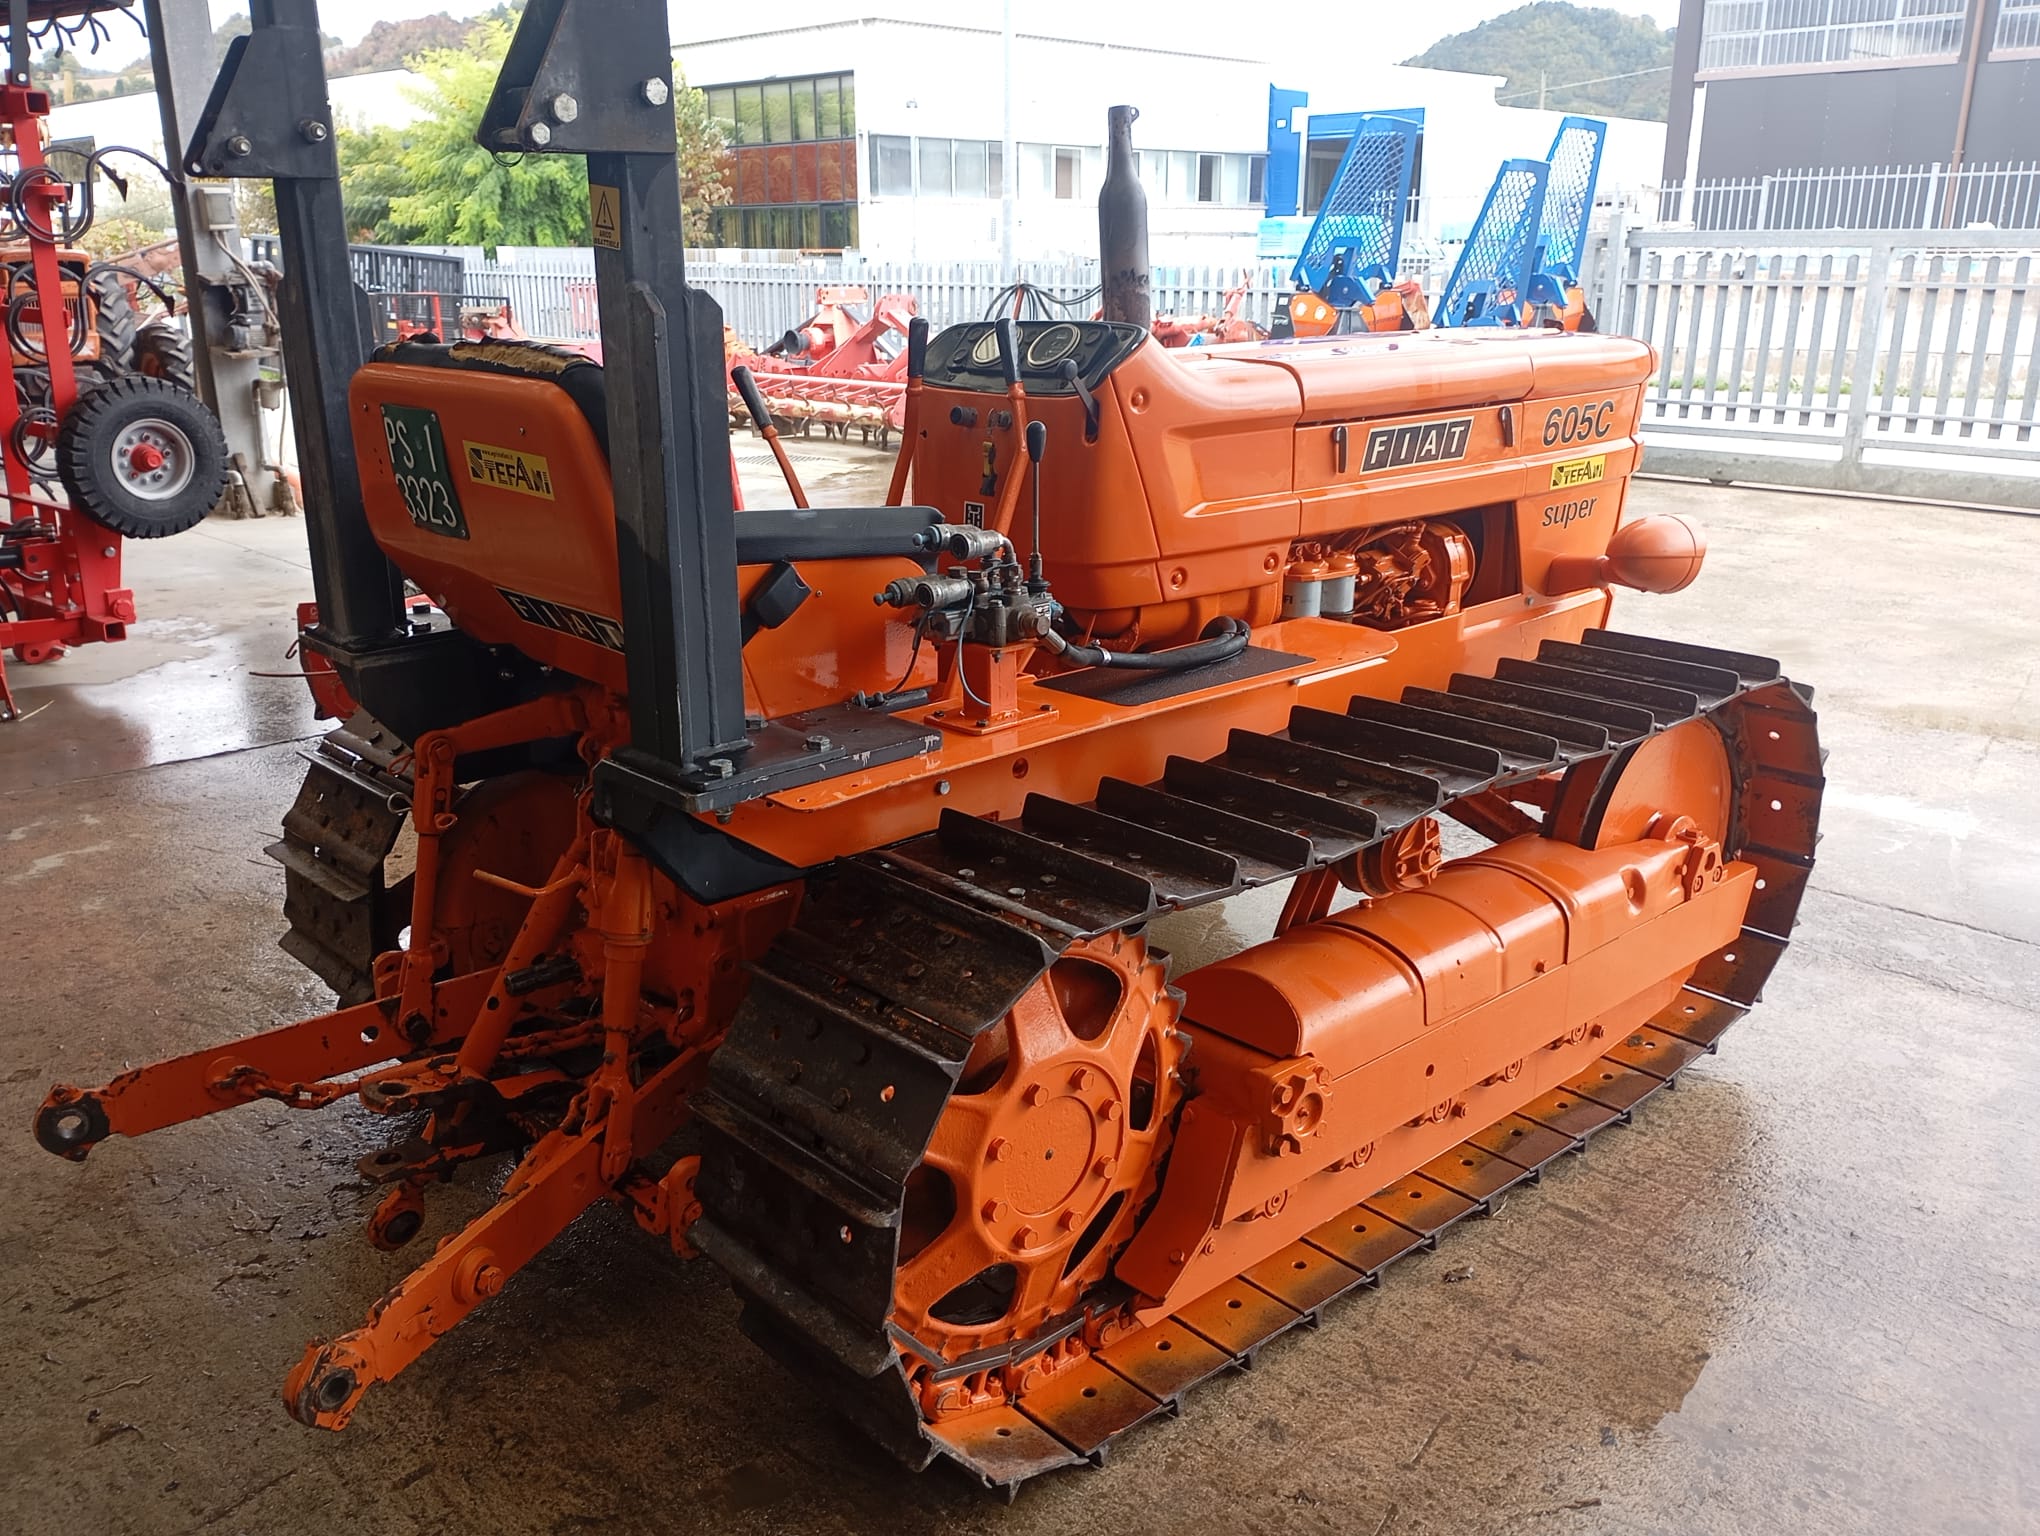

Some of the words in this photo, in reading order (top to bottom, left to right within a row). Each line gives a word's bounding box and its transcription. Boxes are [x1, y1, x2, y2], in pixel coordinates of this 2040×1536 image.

[383, 416, 415, 470] PS
[423, 423, 437, 473] 1
[1368, 424, 1467, 467] FIAT
[1542, 400, 1615, 447] 605C
[395, 473, 457, 528] 3323
[1542, 496, 1597, 530] super
[506, 593, 623, 649] FIAT
